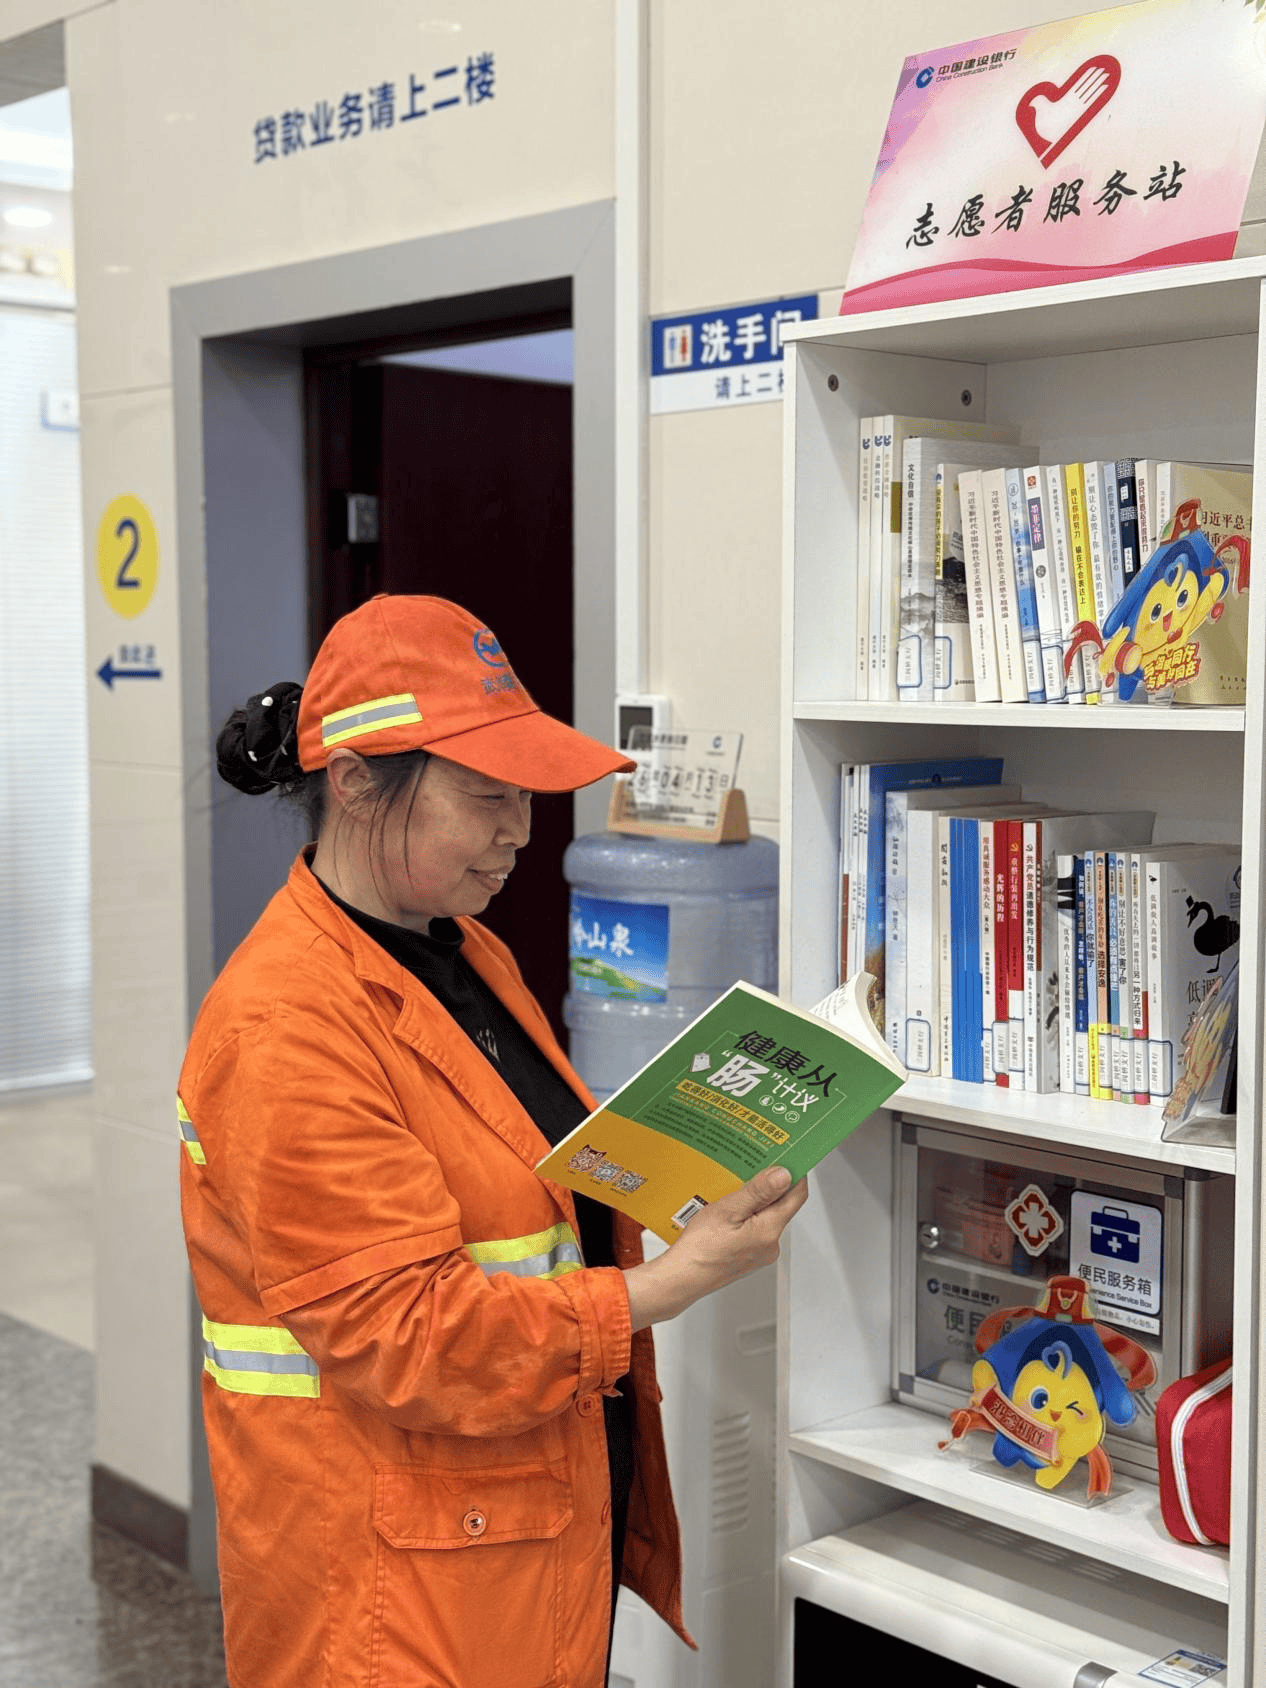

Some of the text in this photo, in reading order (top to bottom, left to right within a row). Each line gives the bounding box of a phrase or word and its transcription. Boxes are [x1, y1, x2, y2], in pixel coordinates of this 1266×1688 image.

[936, 62, 1004, 83] China Construction Bank
[937, 48, 1017, 76] 中国建设银行
[253, 52, 497, 164] 贷款业务请上二楼
[905, 161, 1187, 249] 志愿者服务站
[907, 463, 915, 498] 文化自信
[115, 519, 141, 589] 2
[1070, 487, 1087, 605] 别让你的努力 输在不会表达上
[996, 873, 1005, 923] 光辉的历程
[1025, 855, 1035, 972] 共产党员道德修养与行为规范
[733, 1030, 838, 1097] 健康人
[1078, 1263, 1152, 1296] 便民服务箱
[1116, 1292, 1139, 1306] Service
[1139, 1299, 1153, 1309] Box
